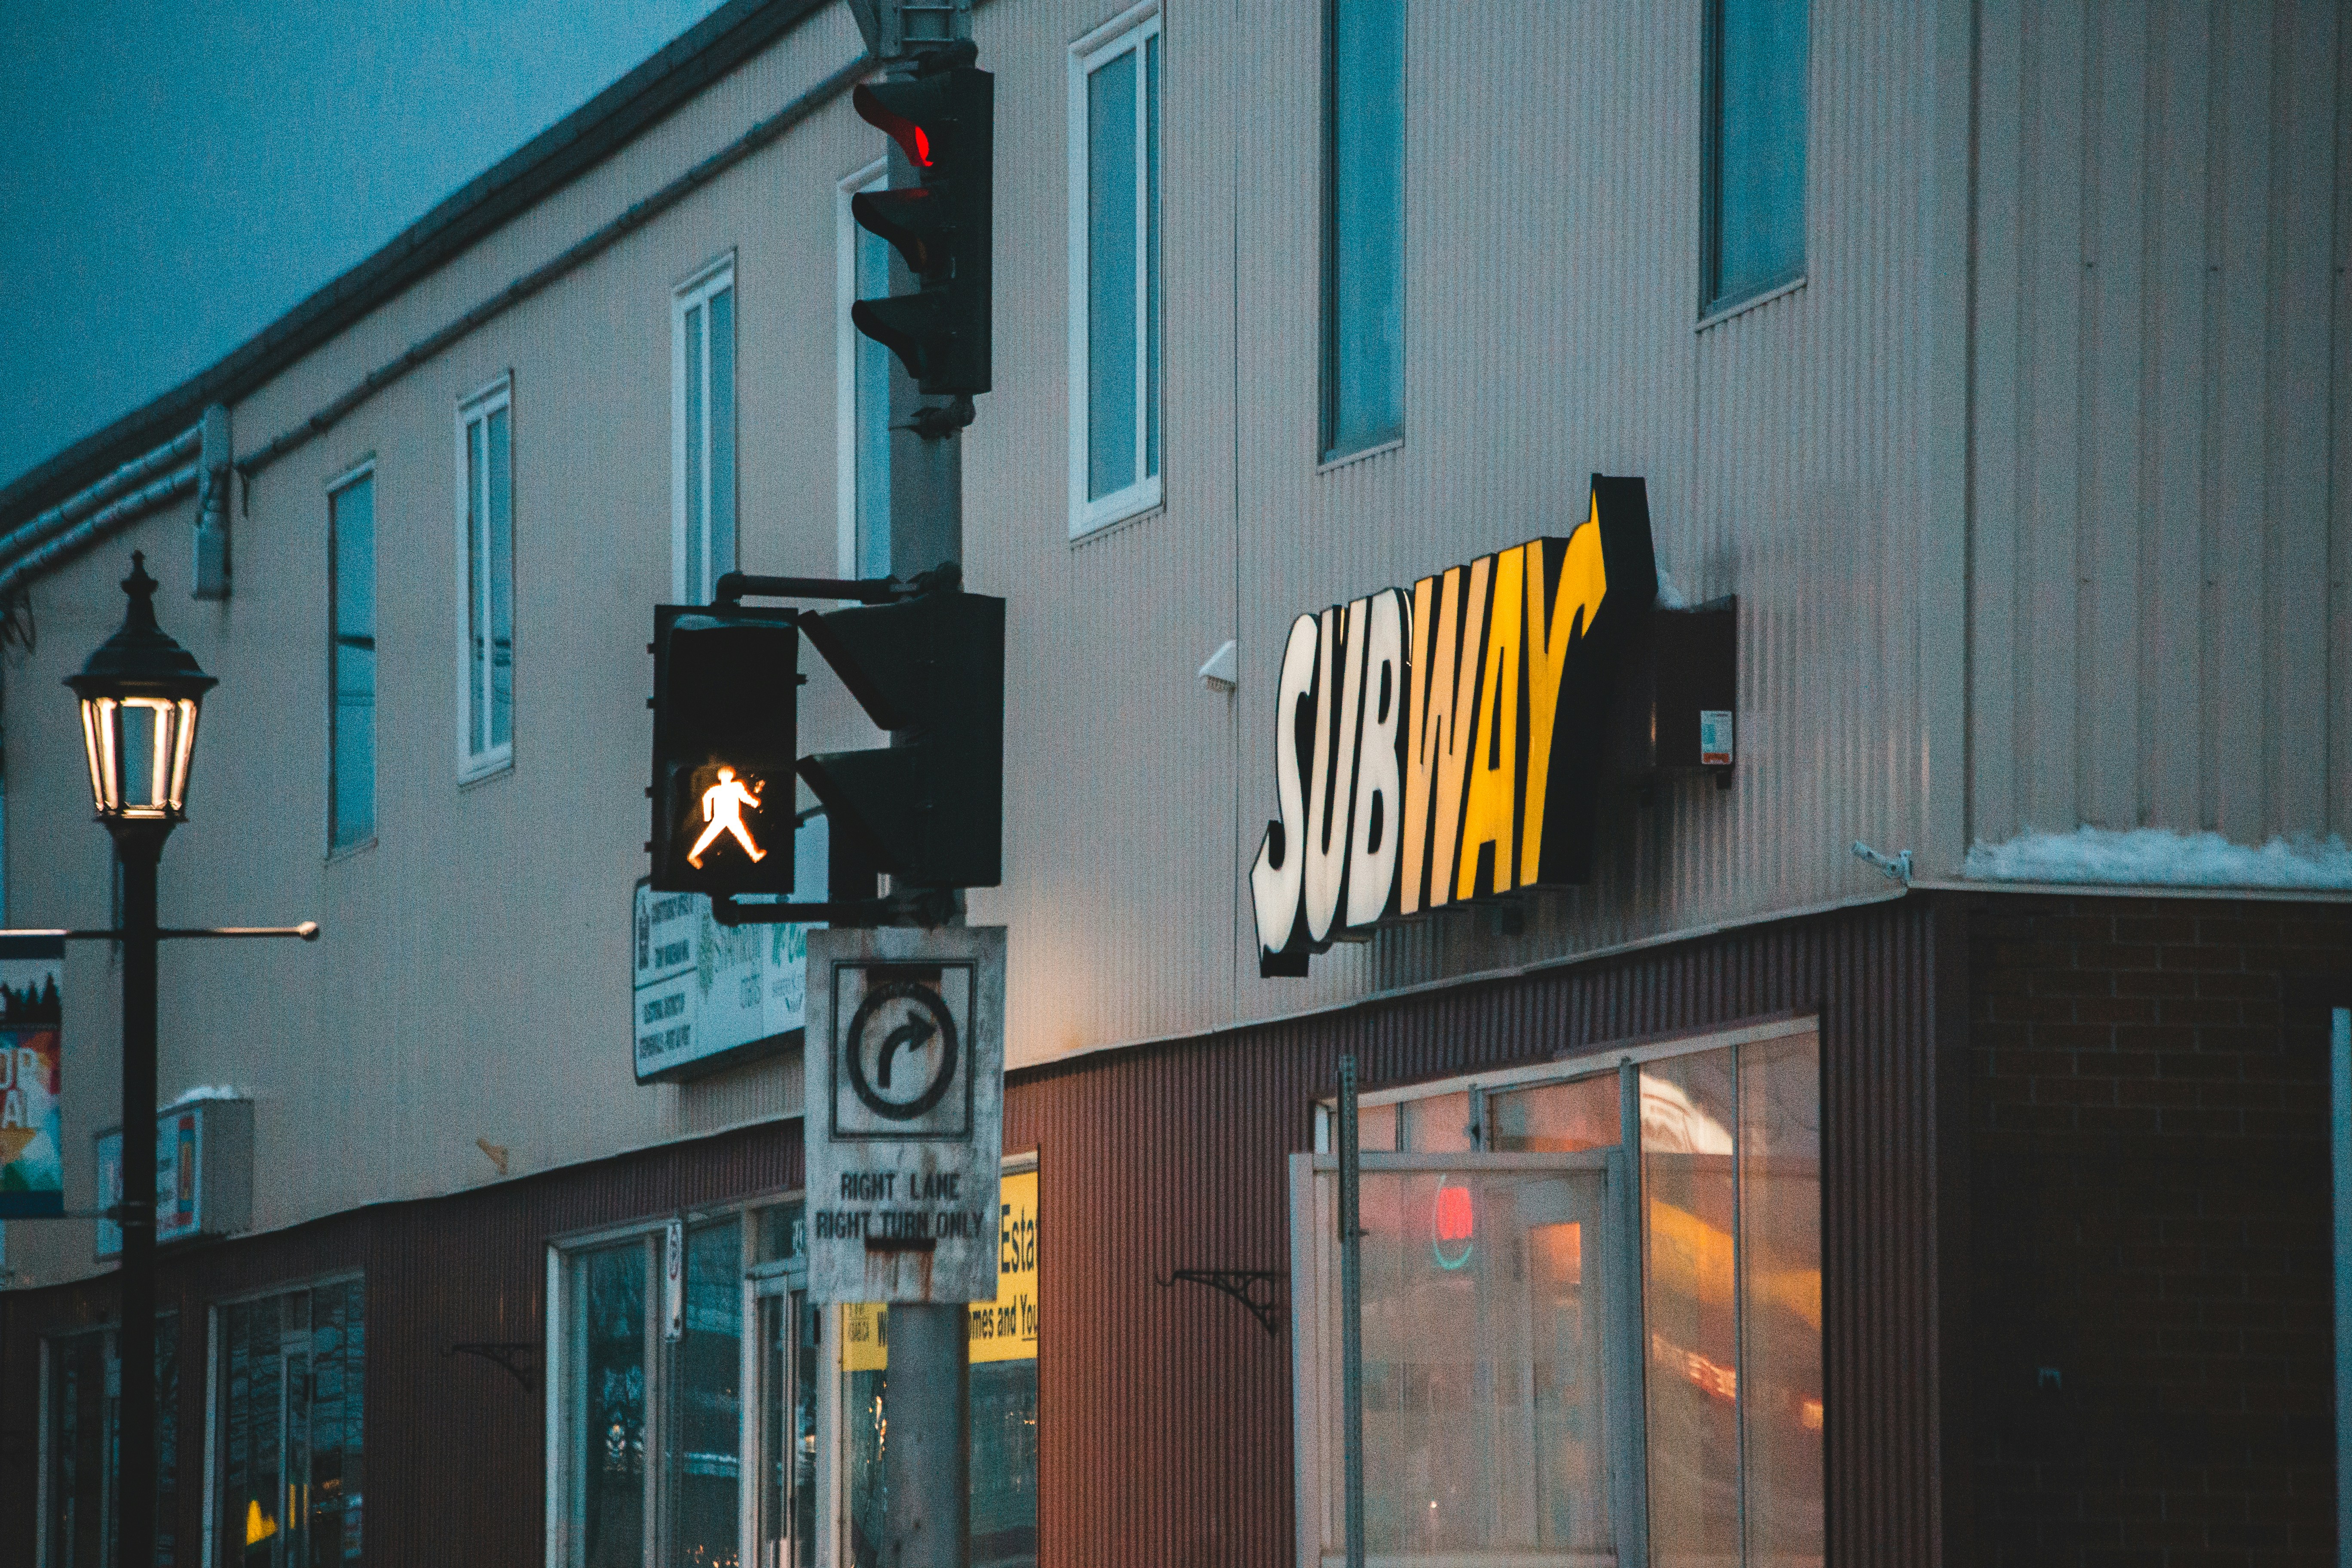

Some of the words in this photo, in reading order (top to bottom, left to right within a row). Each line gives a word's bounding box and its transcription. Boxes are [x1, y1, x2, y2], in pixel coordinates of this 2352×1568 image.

[1250, 487, 1608, 964] SUBWAY
[841, 1173, 895, 1200] RIGHT
[910, 1173, 961, 1200] LANE
[816, 1211, 871, 1240] RIGHT
[880, 1211, 929, 1240] TURN
[937, 1211, 985, 1240] ONLY
[1001, 1204, 1038, 1274] Esta
[969, 1308, 994, 1340] mes
[998, 1294, 1017, 1338] and
